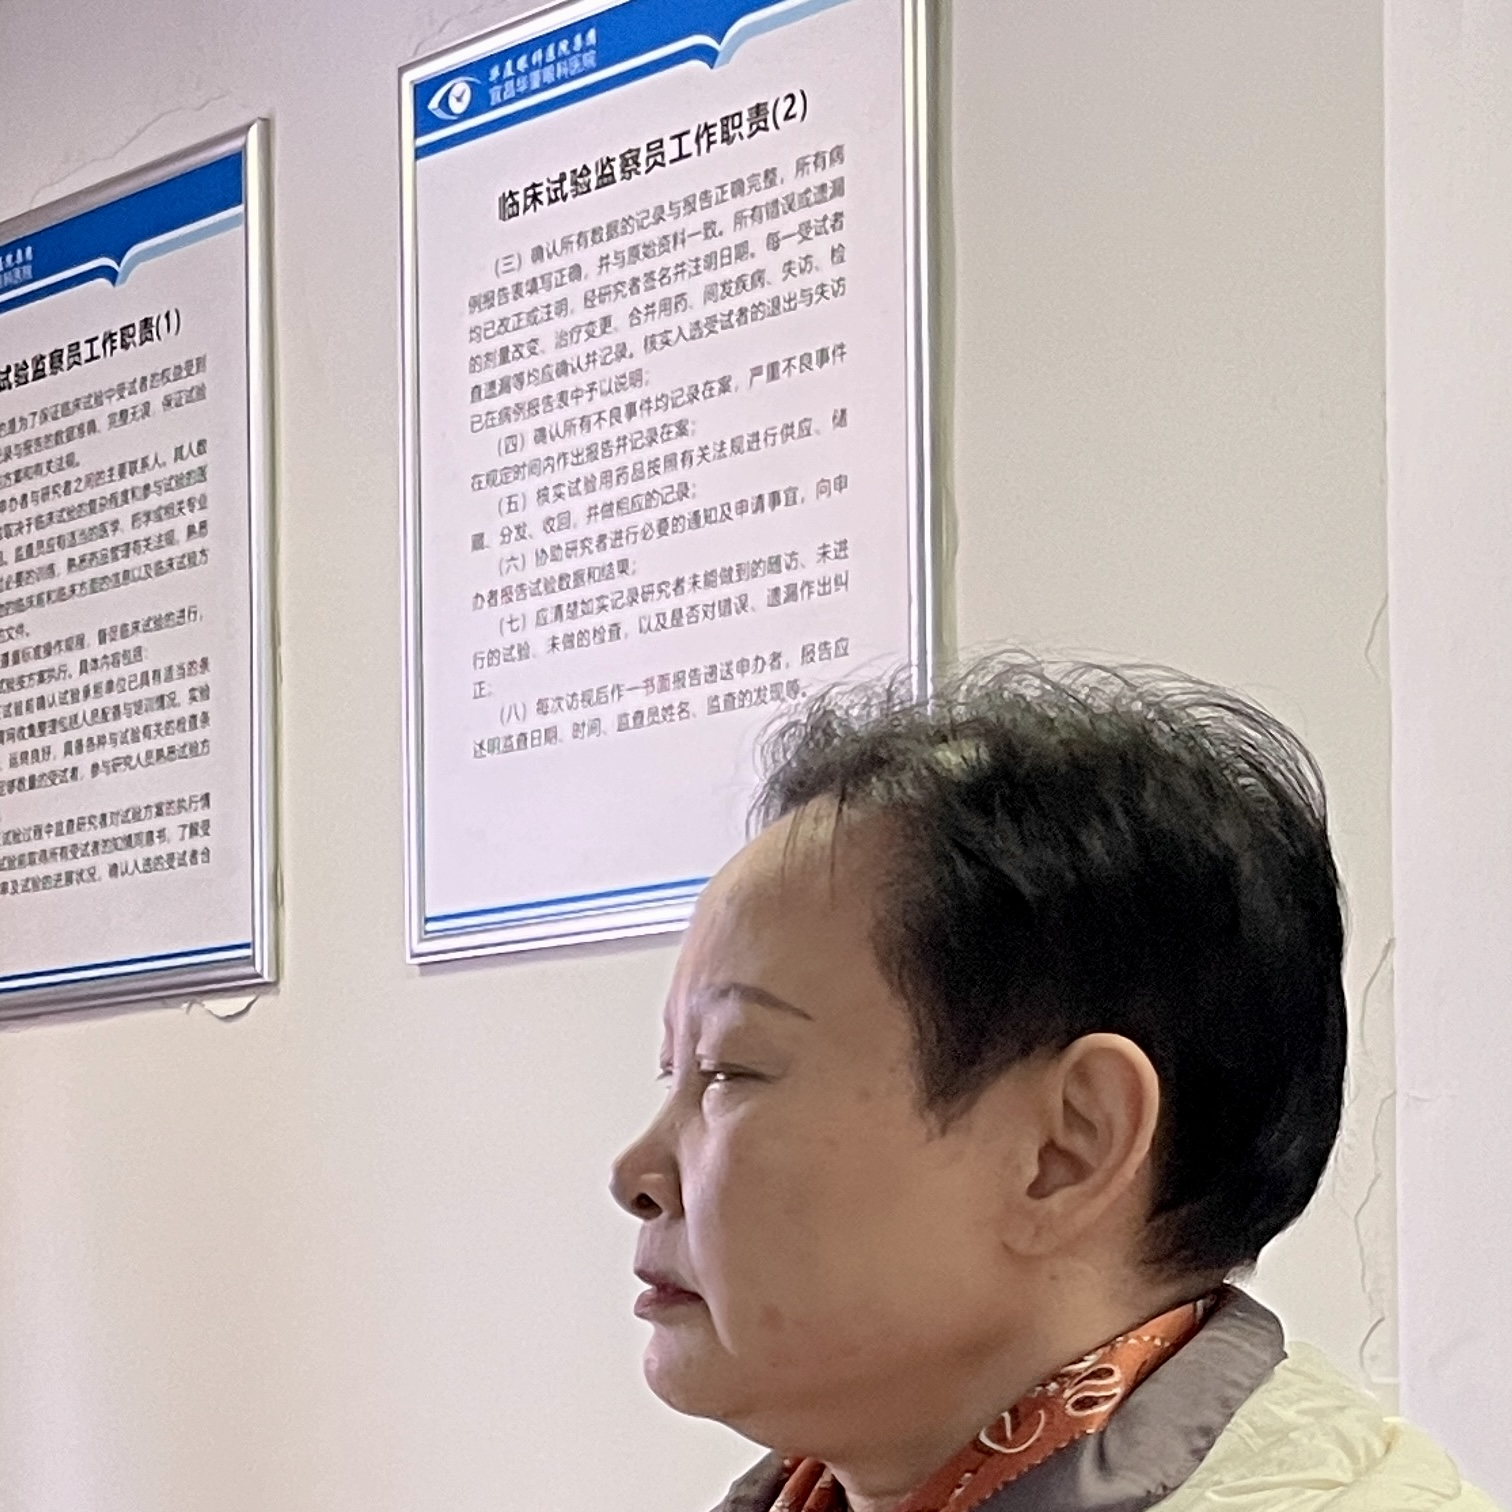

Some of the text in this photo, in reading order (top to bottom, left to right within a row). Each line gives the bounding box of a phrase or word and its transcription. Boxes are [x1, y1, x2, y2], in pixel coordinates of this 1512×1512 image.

[498, 90, 806, 220] 临床试验监察员工作职责(2)
